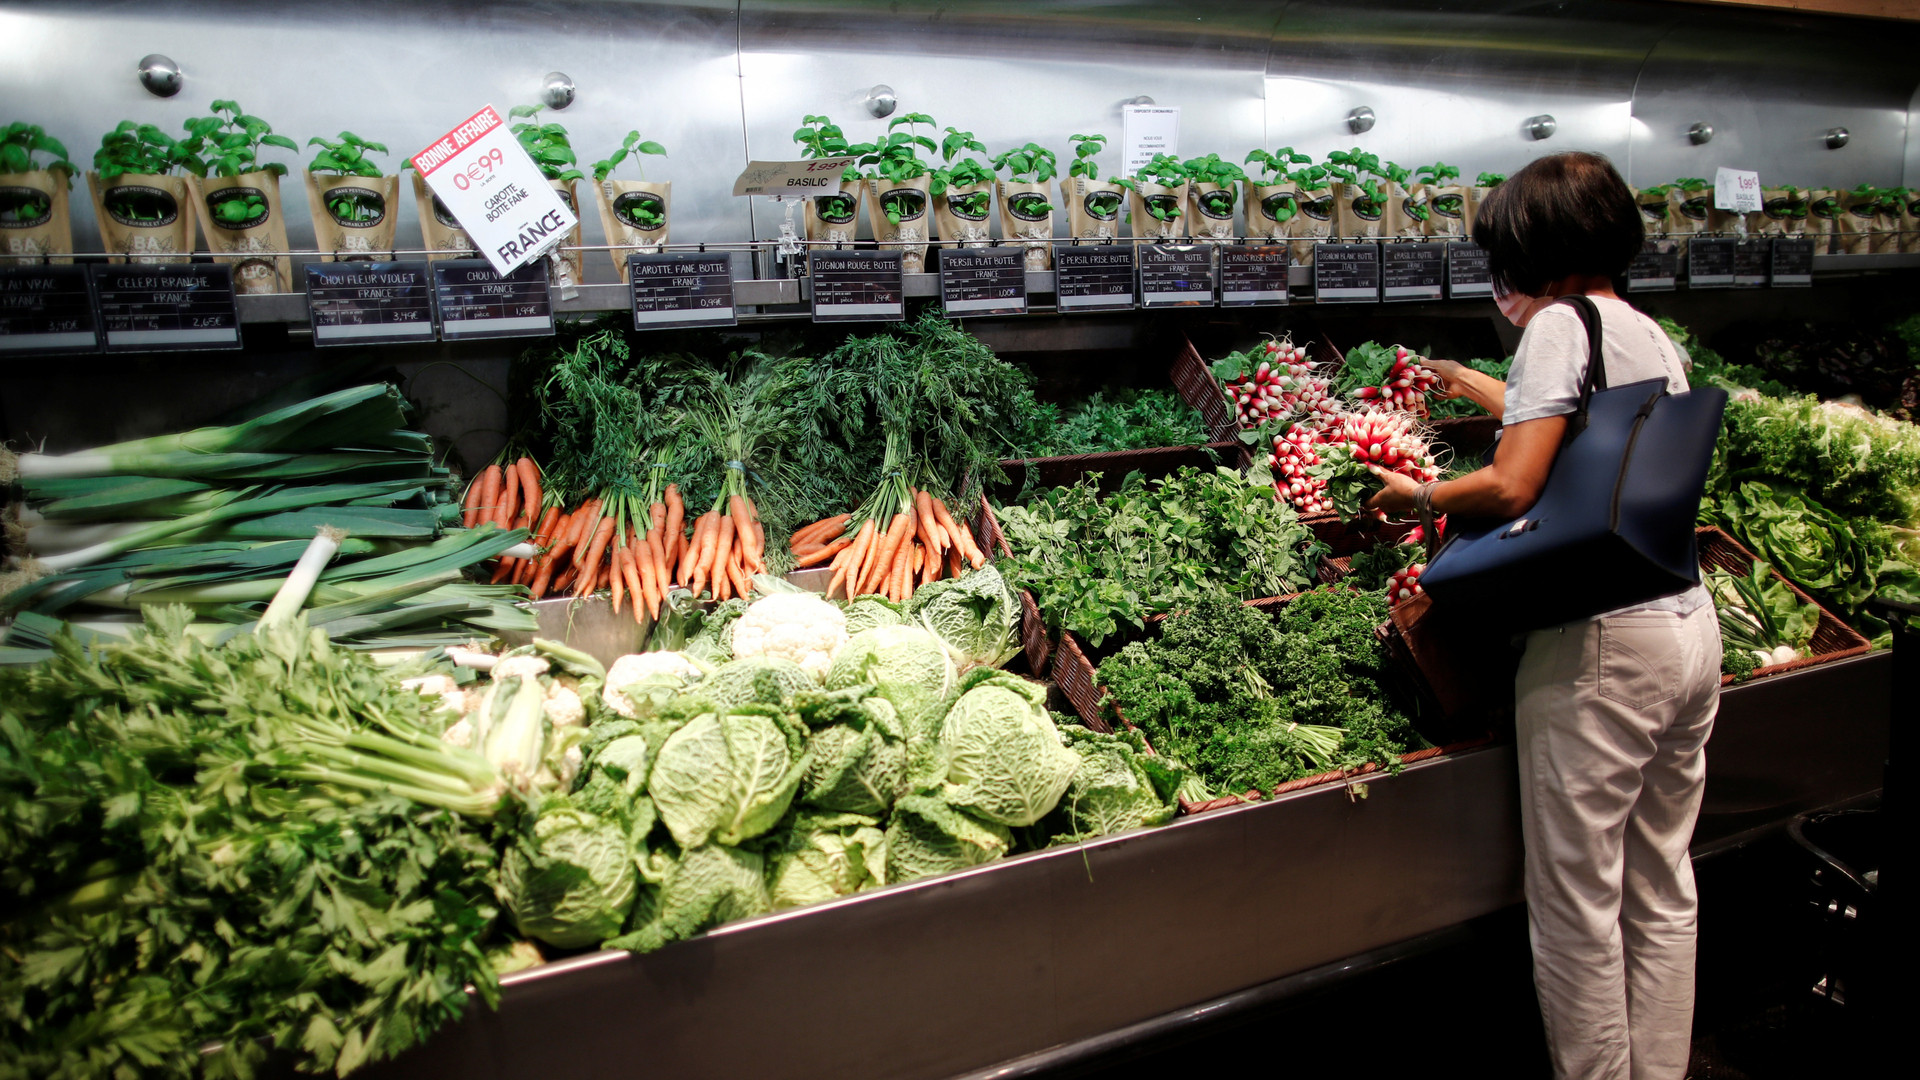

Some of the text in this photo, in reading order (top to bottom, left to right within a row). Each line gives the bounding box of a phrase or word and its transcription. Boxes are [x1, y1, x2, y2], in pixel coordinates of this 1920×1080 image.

[416, 110, 499, 174] BONNE AFFAIRE
[453, 148, 503, 191] 0€99
[806, 160, 850, 173] 1,99€
[787, 178, 829, 187] BASILIC
[130, 187, 162, 195] PESTICIDES
[213, 190, 227, 198] SANS
[484, 183, 518, 210] CAROTTE
[486, 188, 529, 222] BOTTE FANE
[497, 209, 565, 265] FRANCE
[900, 229, 918, 241] BA
[9, 238, 38, 252] BA
[134, 236, 160, 250] BA
[239, 237, 261, 251] BA
[346, 236, 370, 249] BA
[950, 256, 1016, 267] PERSIL PLAT BOTTE
[1066, 256, 1089, 264] PERSIL
[1110, 255, 1131, 263] BOTTE
[1154, 254, 1204, 262] MENTHE BOTTE
[1266, 254, 1284, 262] BOTTE
[636, 263, 726, 275] CAROTTE FANE BOTTE
[816, 260, 897, 270] OIGNON ROUGE BOTTE
[1169, 265, 1190, 273] FRANCE
[1248, 265, 1268, 273] FRANCE
[320, 274, 416, 286] CHOU FLEUR VIOLET
[466, 272, 490, 282] CHOU
[975, 271, 999, 279] FRANCE
[26, 278, 57, 290] VRAC
[117, 276, 210, 289] CELERI BRANCHE
[672, 278, 702, 287] FRANCE
[358, 289, 393, 299] FRANCE
[482, 286, 516, 295] FRANCE
[153, 293, 194, 303] FRANCE
[515, 306, 537, 316] 1,99€
[193, 317, 222, 327] 2,65€
